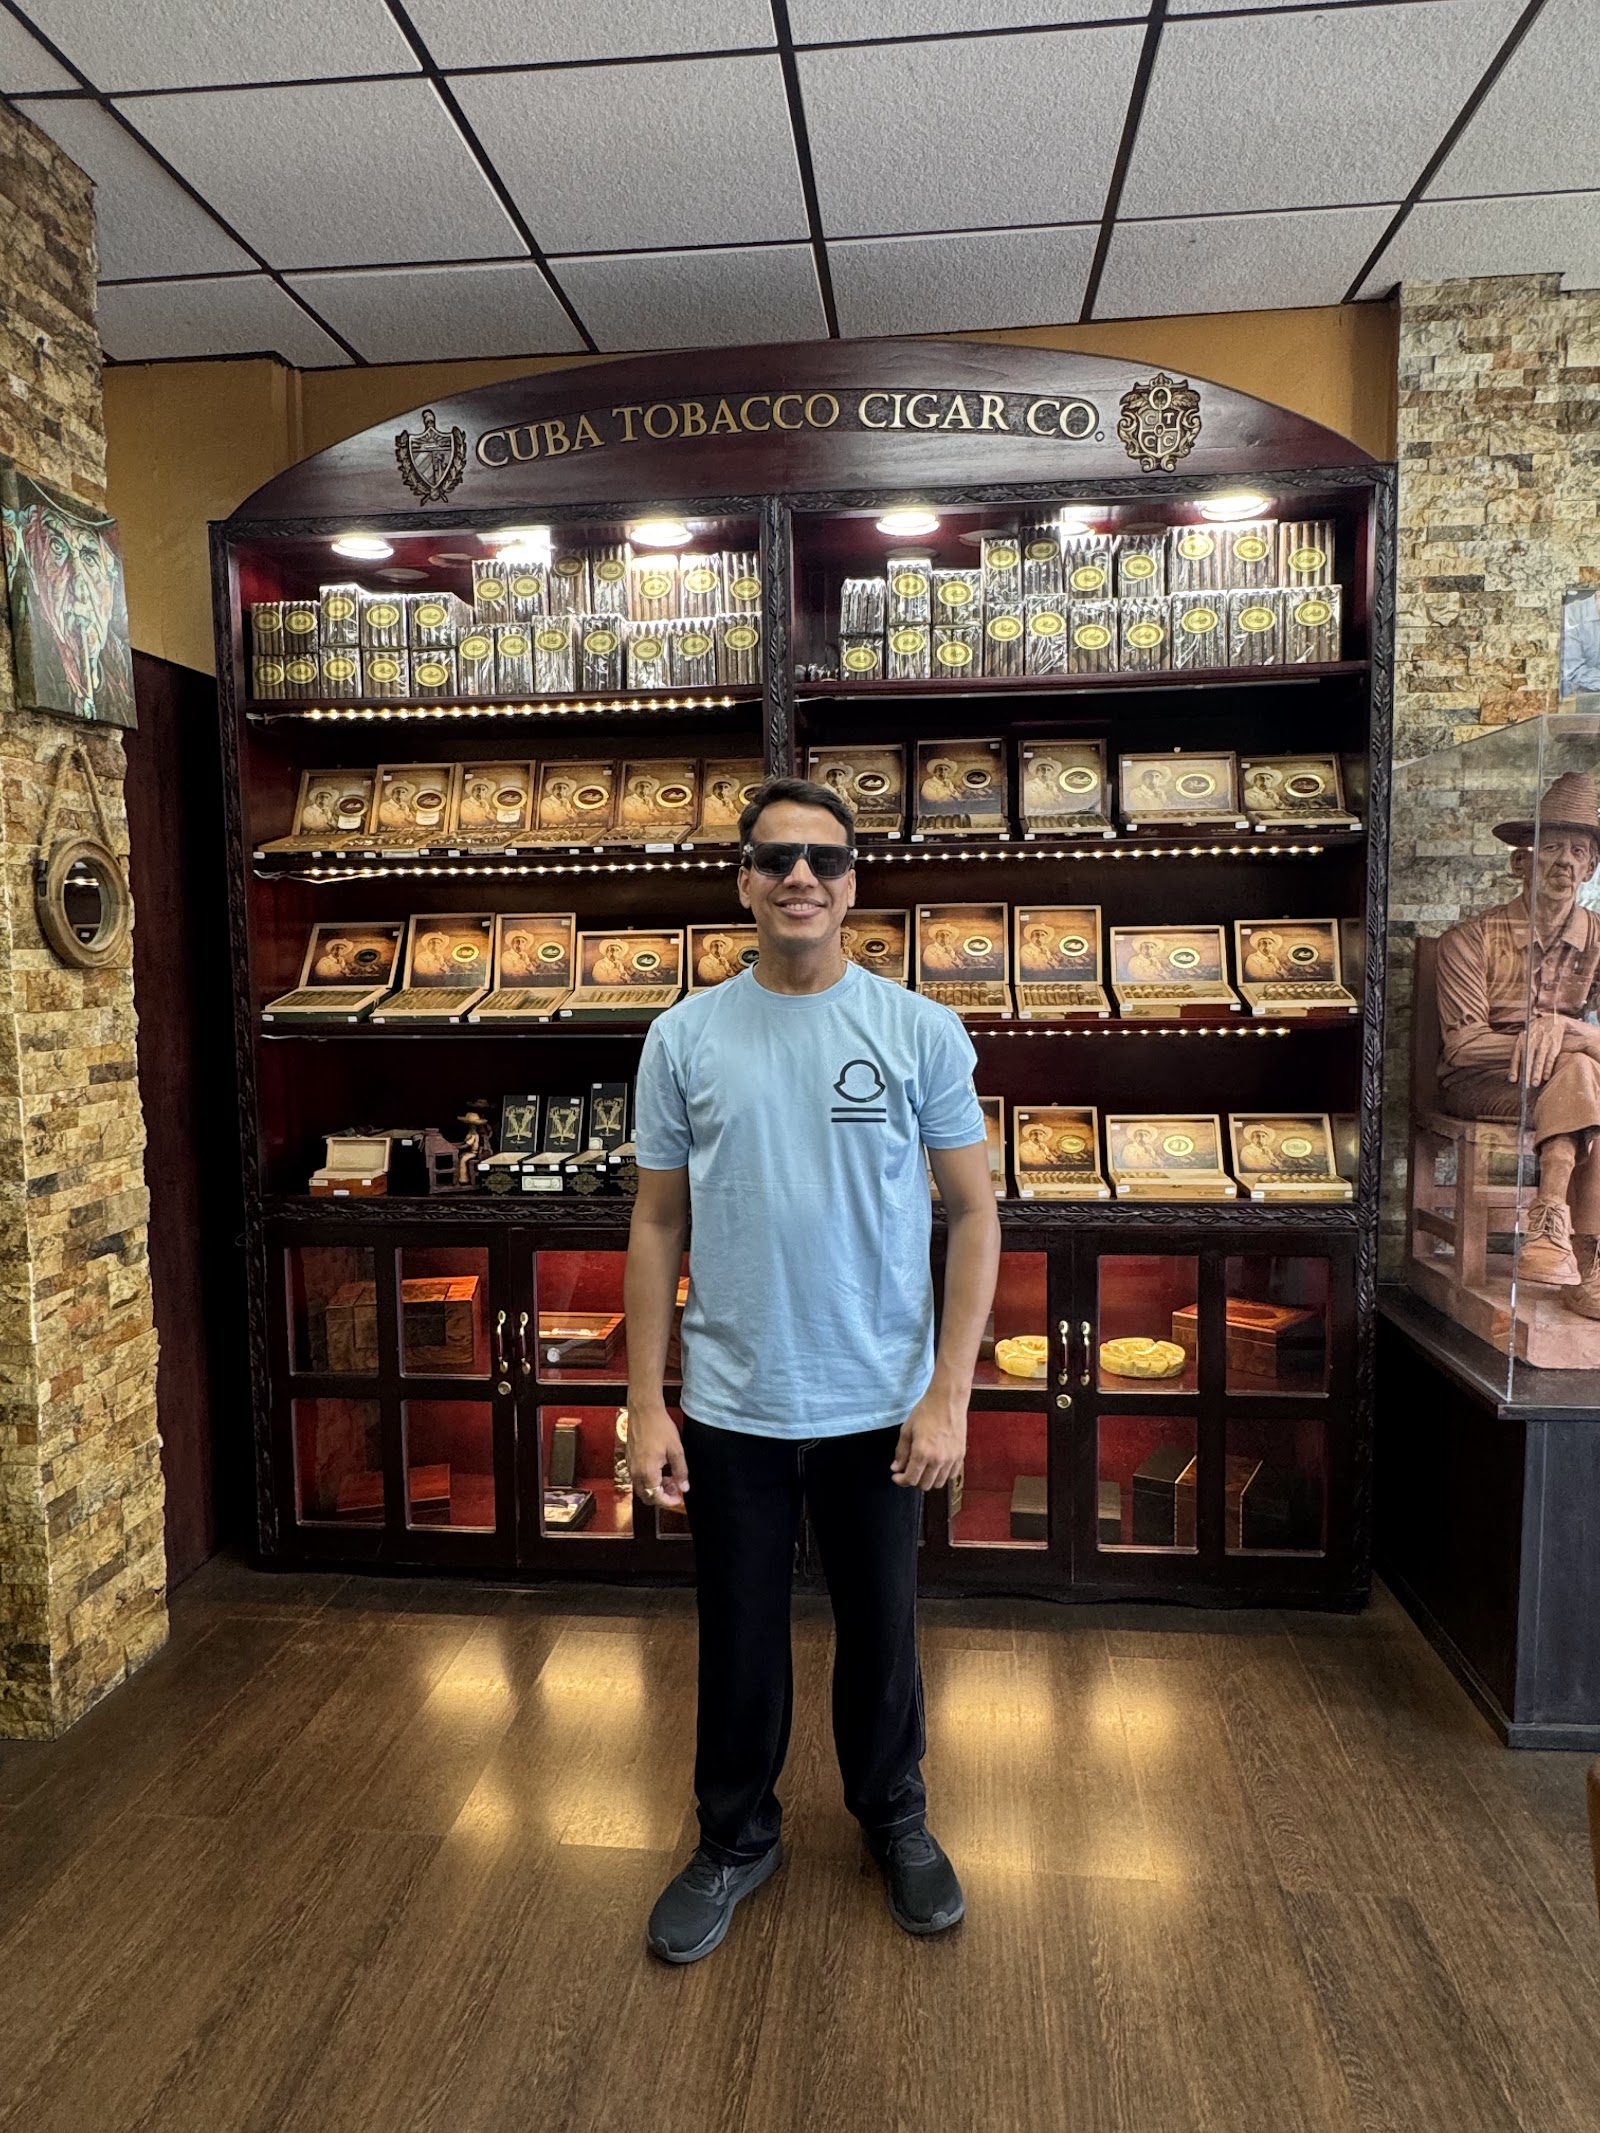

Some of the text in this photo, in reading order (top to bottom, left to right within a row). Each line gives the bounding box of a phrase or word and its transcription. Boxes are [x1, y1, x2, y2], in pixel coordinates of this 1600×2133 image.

[477, 393, 1105, 467] CUBA TOBACCO CIGAR CO.
